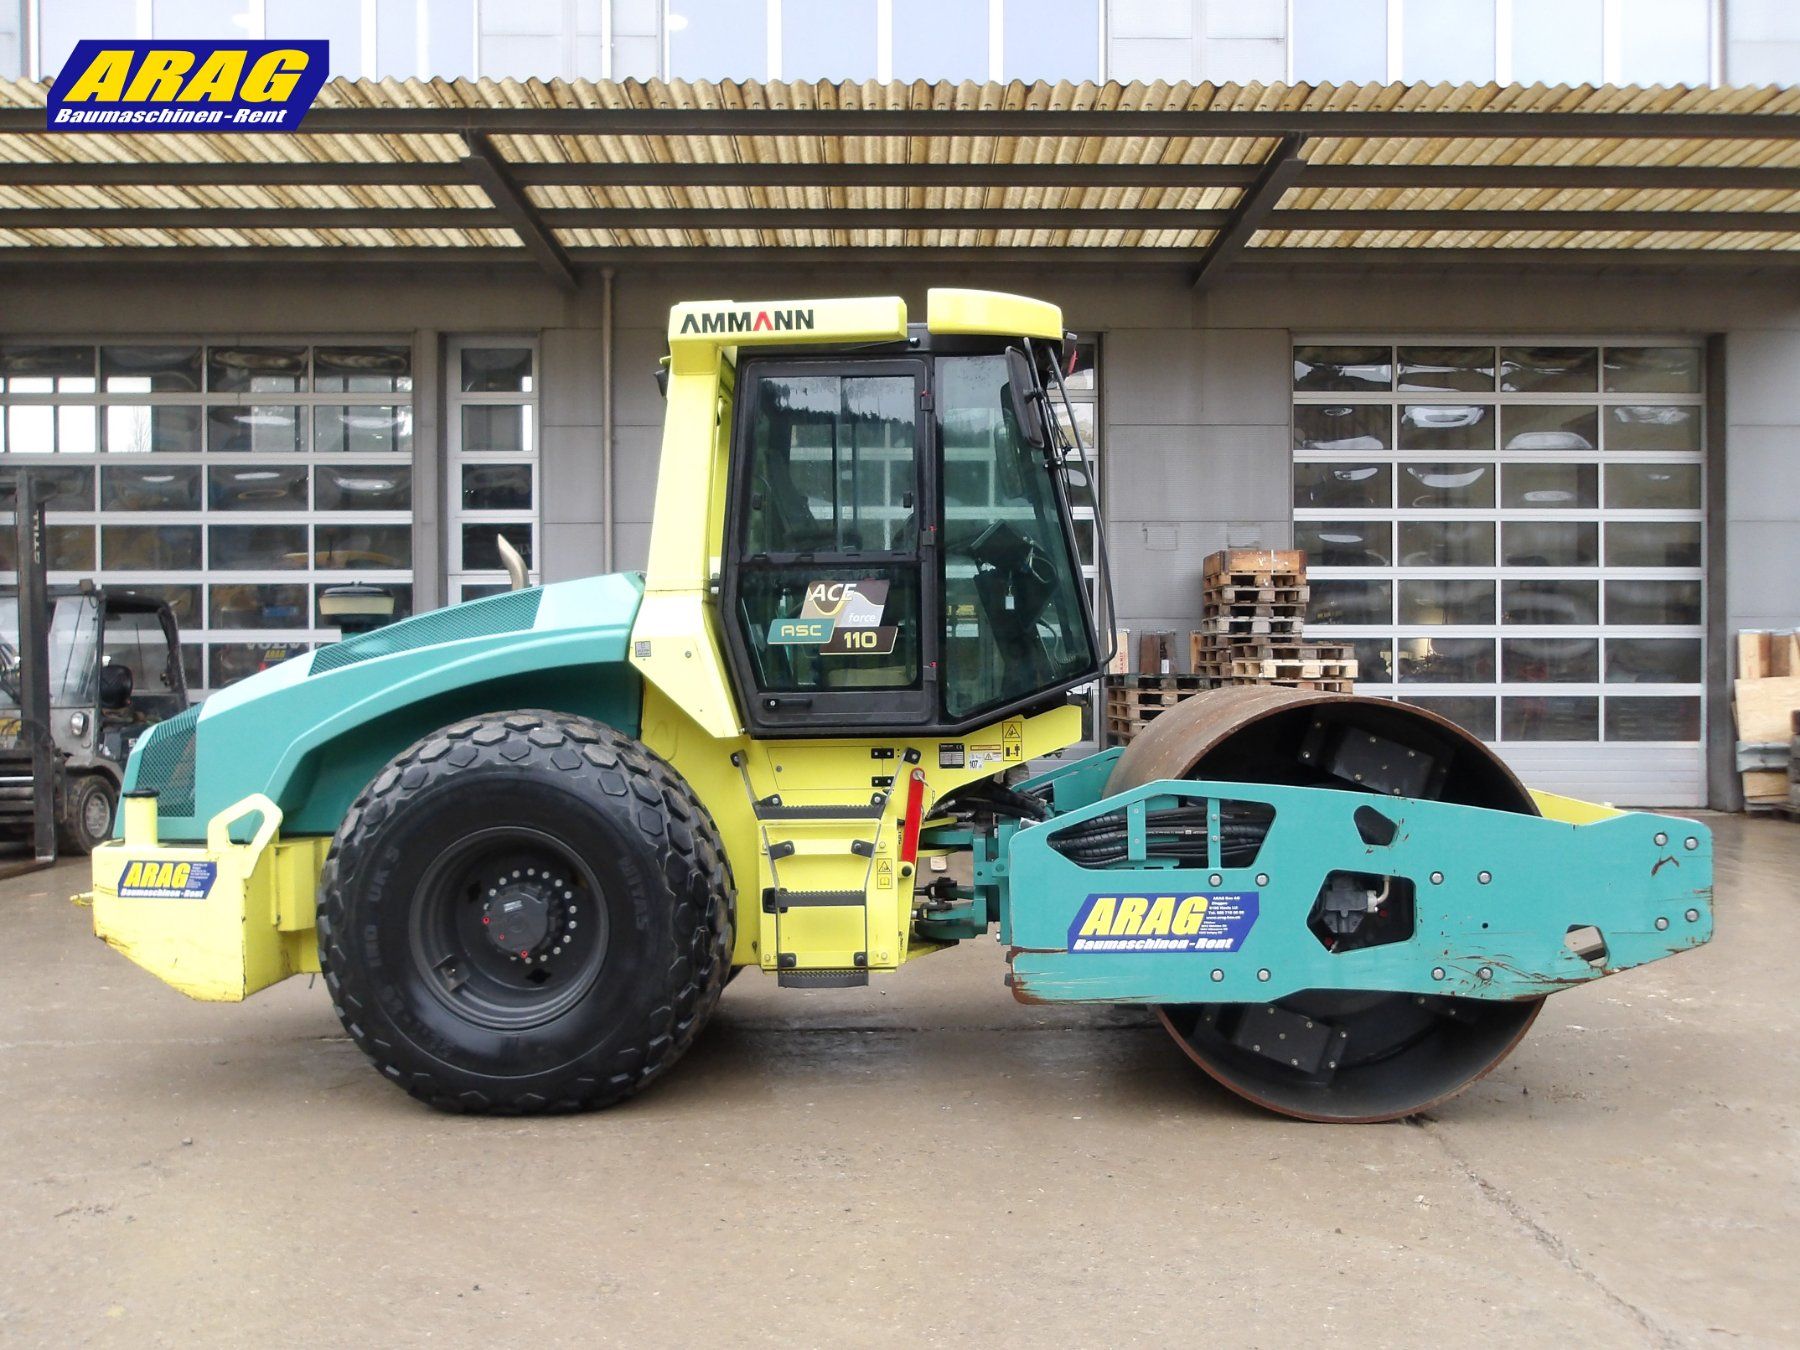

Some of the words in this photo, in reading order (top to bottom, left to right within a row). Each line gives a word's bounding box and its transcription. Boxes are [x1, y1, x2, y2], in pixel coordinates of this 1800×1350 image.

[680, 309, 815, 333] AMMANN
[808, 583, 857, 602] ACE
[847, 612, 876, 623] force
[781, 625, 822, 636] ASC
[844, 631, 877, 648] 110
[123, 862, 191, 888] ARAG
[618, 856, 650, 931] MITAS
[1079, 896, 1209, 936] ARAG
